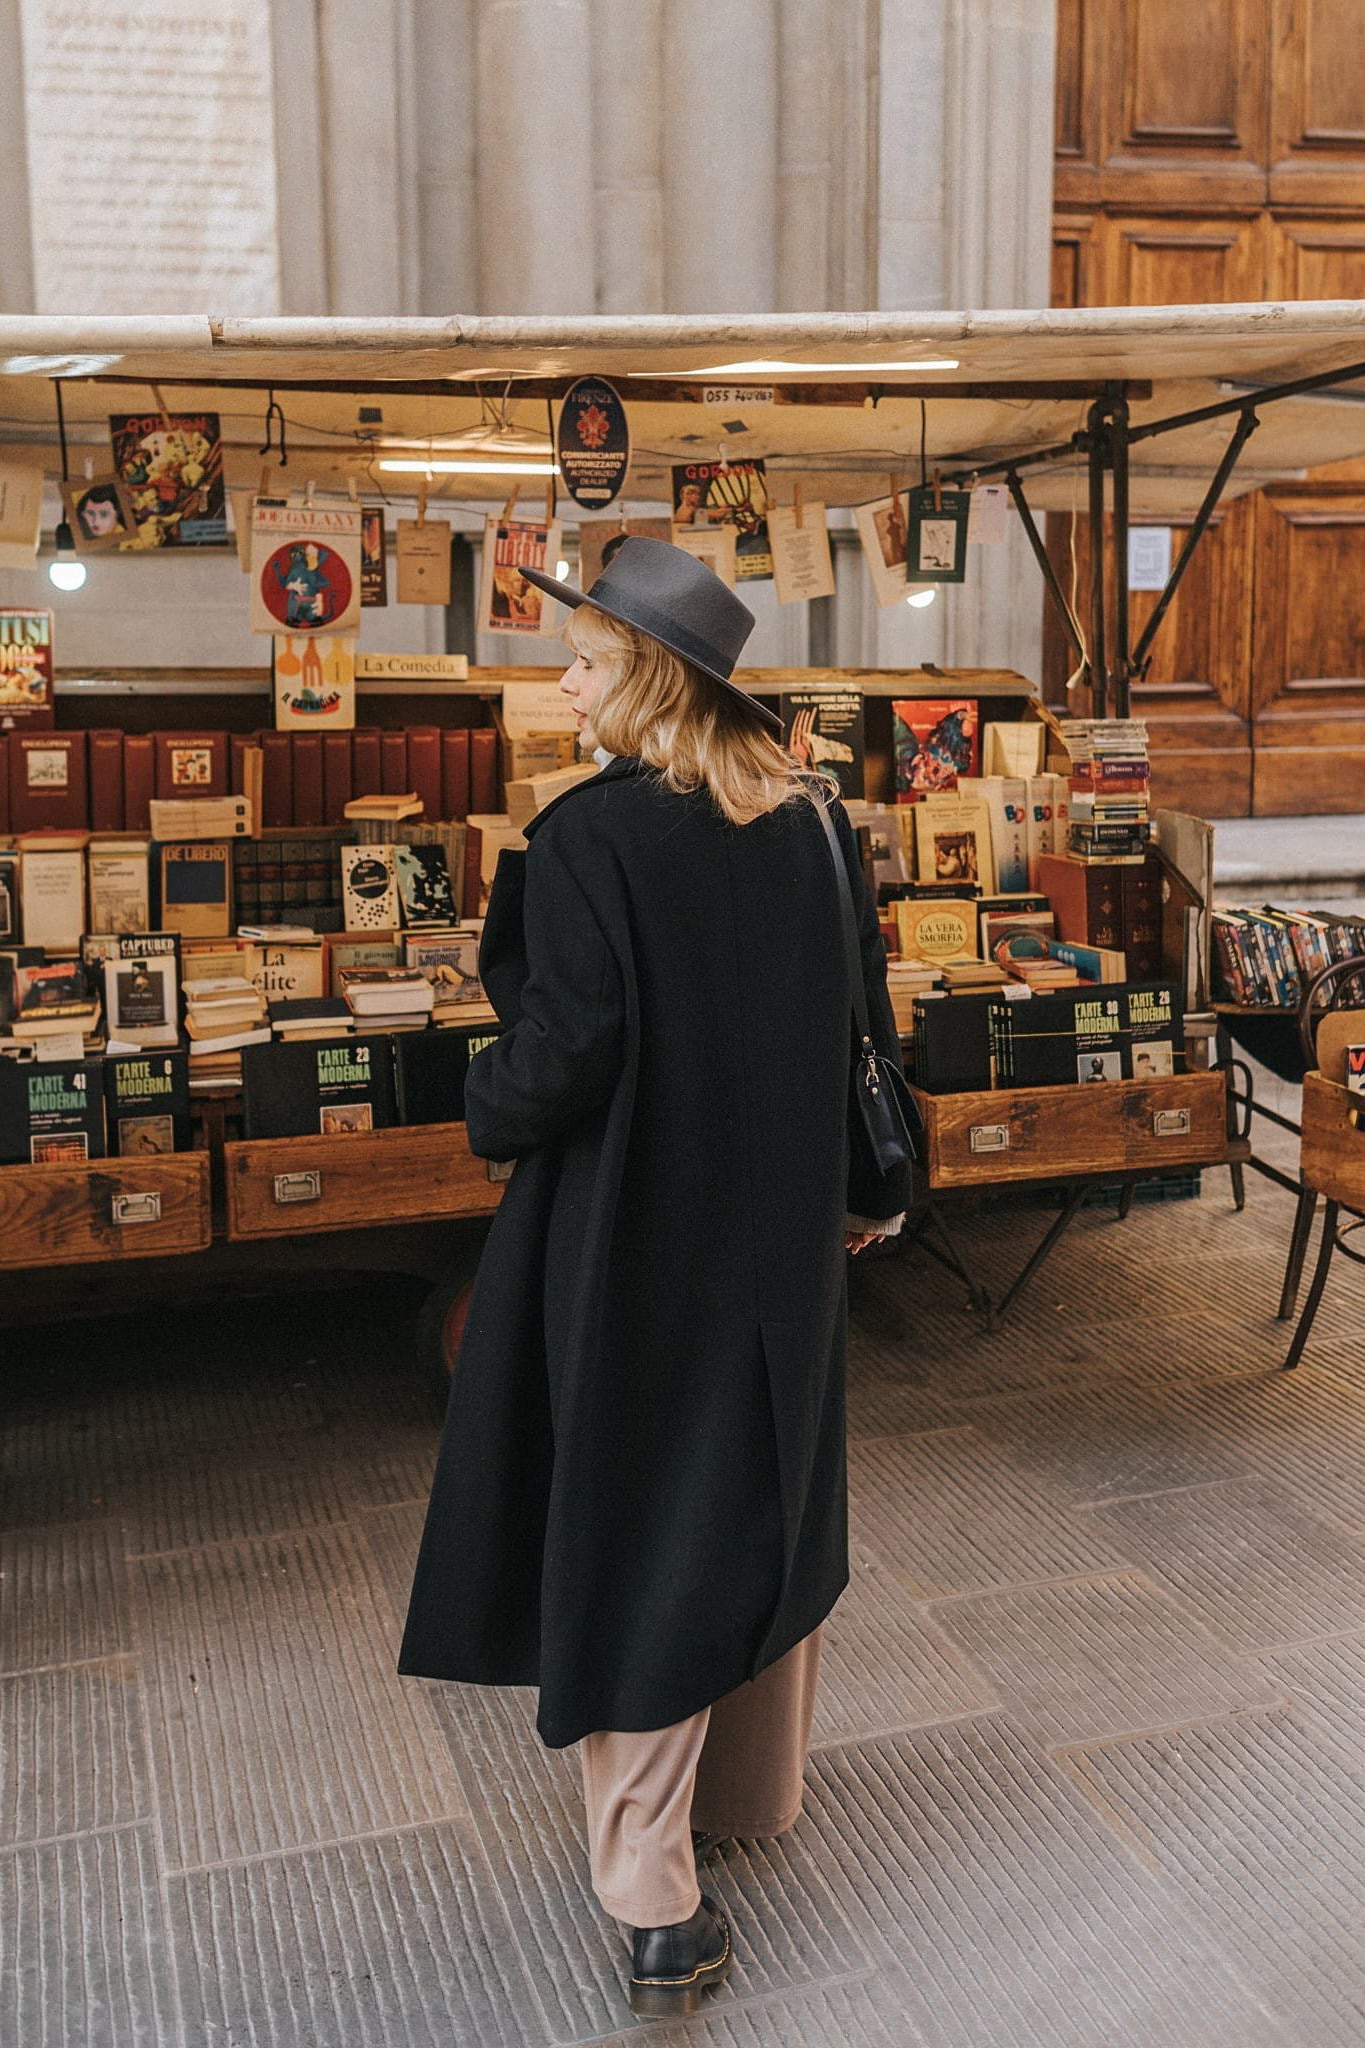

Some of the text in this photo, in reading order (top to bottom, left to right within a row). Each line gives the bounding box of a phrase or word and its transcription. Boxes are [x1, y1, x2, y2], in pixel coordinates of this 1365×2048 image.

[706, 390, 730, 403] 055
[561, 451, 625, 461] COMMERCIANTE
[566, 460, 621, 469] AUTORIZZATO
[363, 658, 456, 674] La Comedia
[166, 847, 182, 861] DE
[919, 923, 963, 933] LA VERA
[121, 938, 175, 951] CAPTURED
[919, 933, 964, 943] SMORFIA
[262, 948, 285, 967] La
[251, 970, 297, 991] élite
[1128, 992, 1154, 1008] L'ARTE
[1074, 1002, 1102, 1018] L'ARTE
[1129, 1006, 1171, 1023] MODERNA
[1075, 1016, 1120, 1034] MODERNA
[316, 1047, 370, 1066] L'ARTE 23
[115, 1062, 150, 1080] L'ARTE
[317, 1064, 371, 1084] MODERNA
[28, 1073, 87, 1094] L'ARTE 41
[116, 1077, 173, 1096] MODERNA
[29, 1092, 87, 1112] MODERNA
